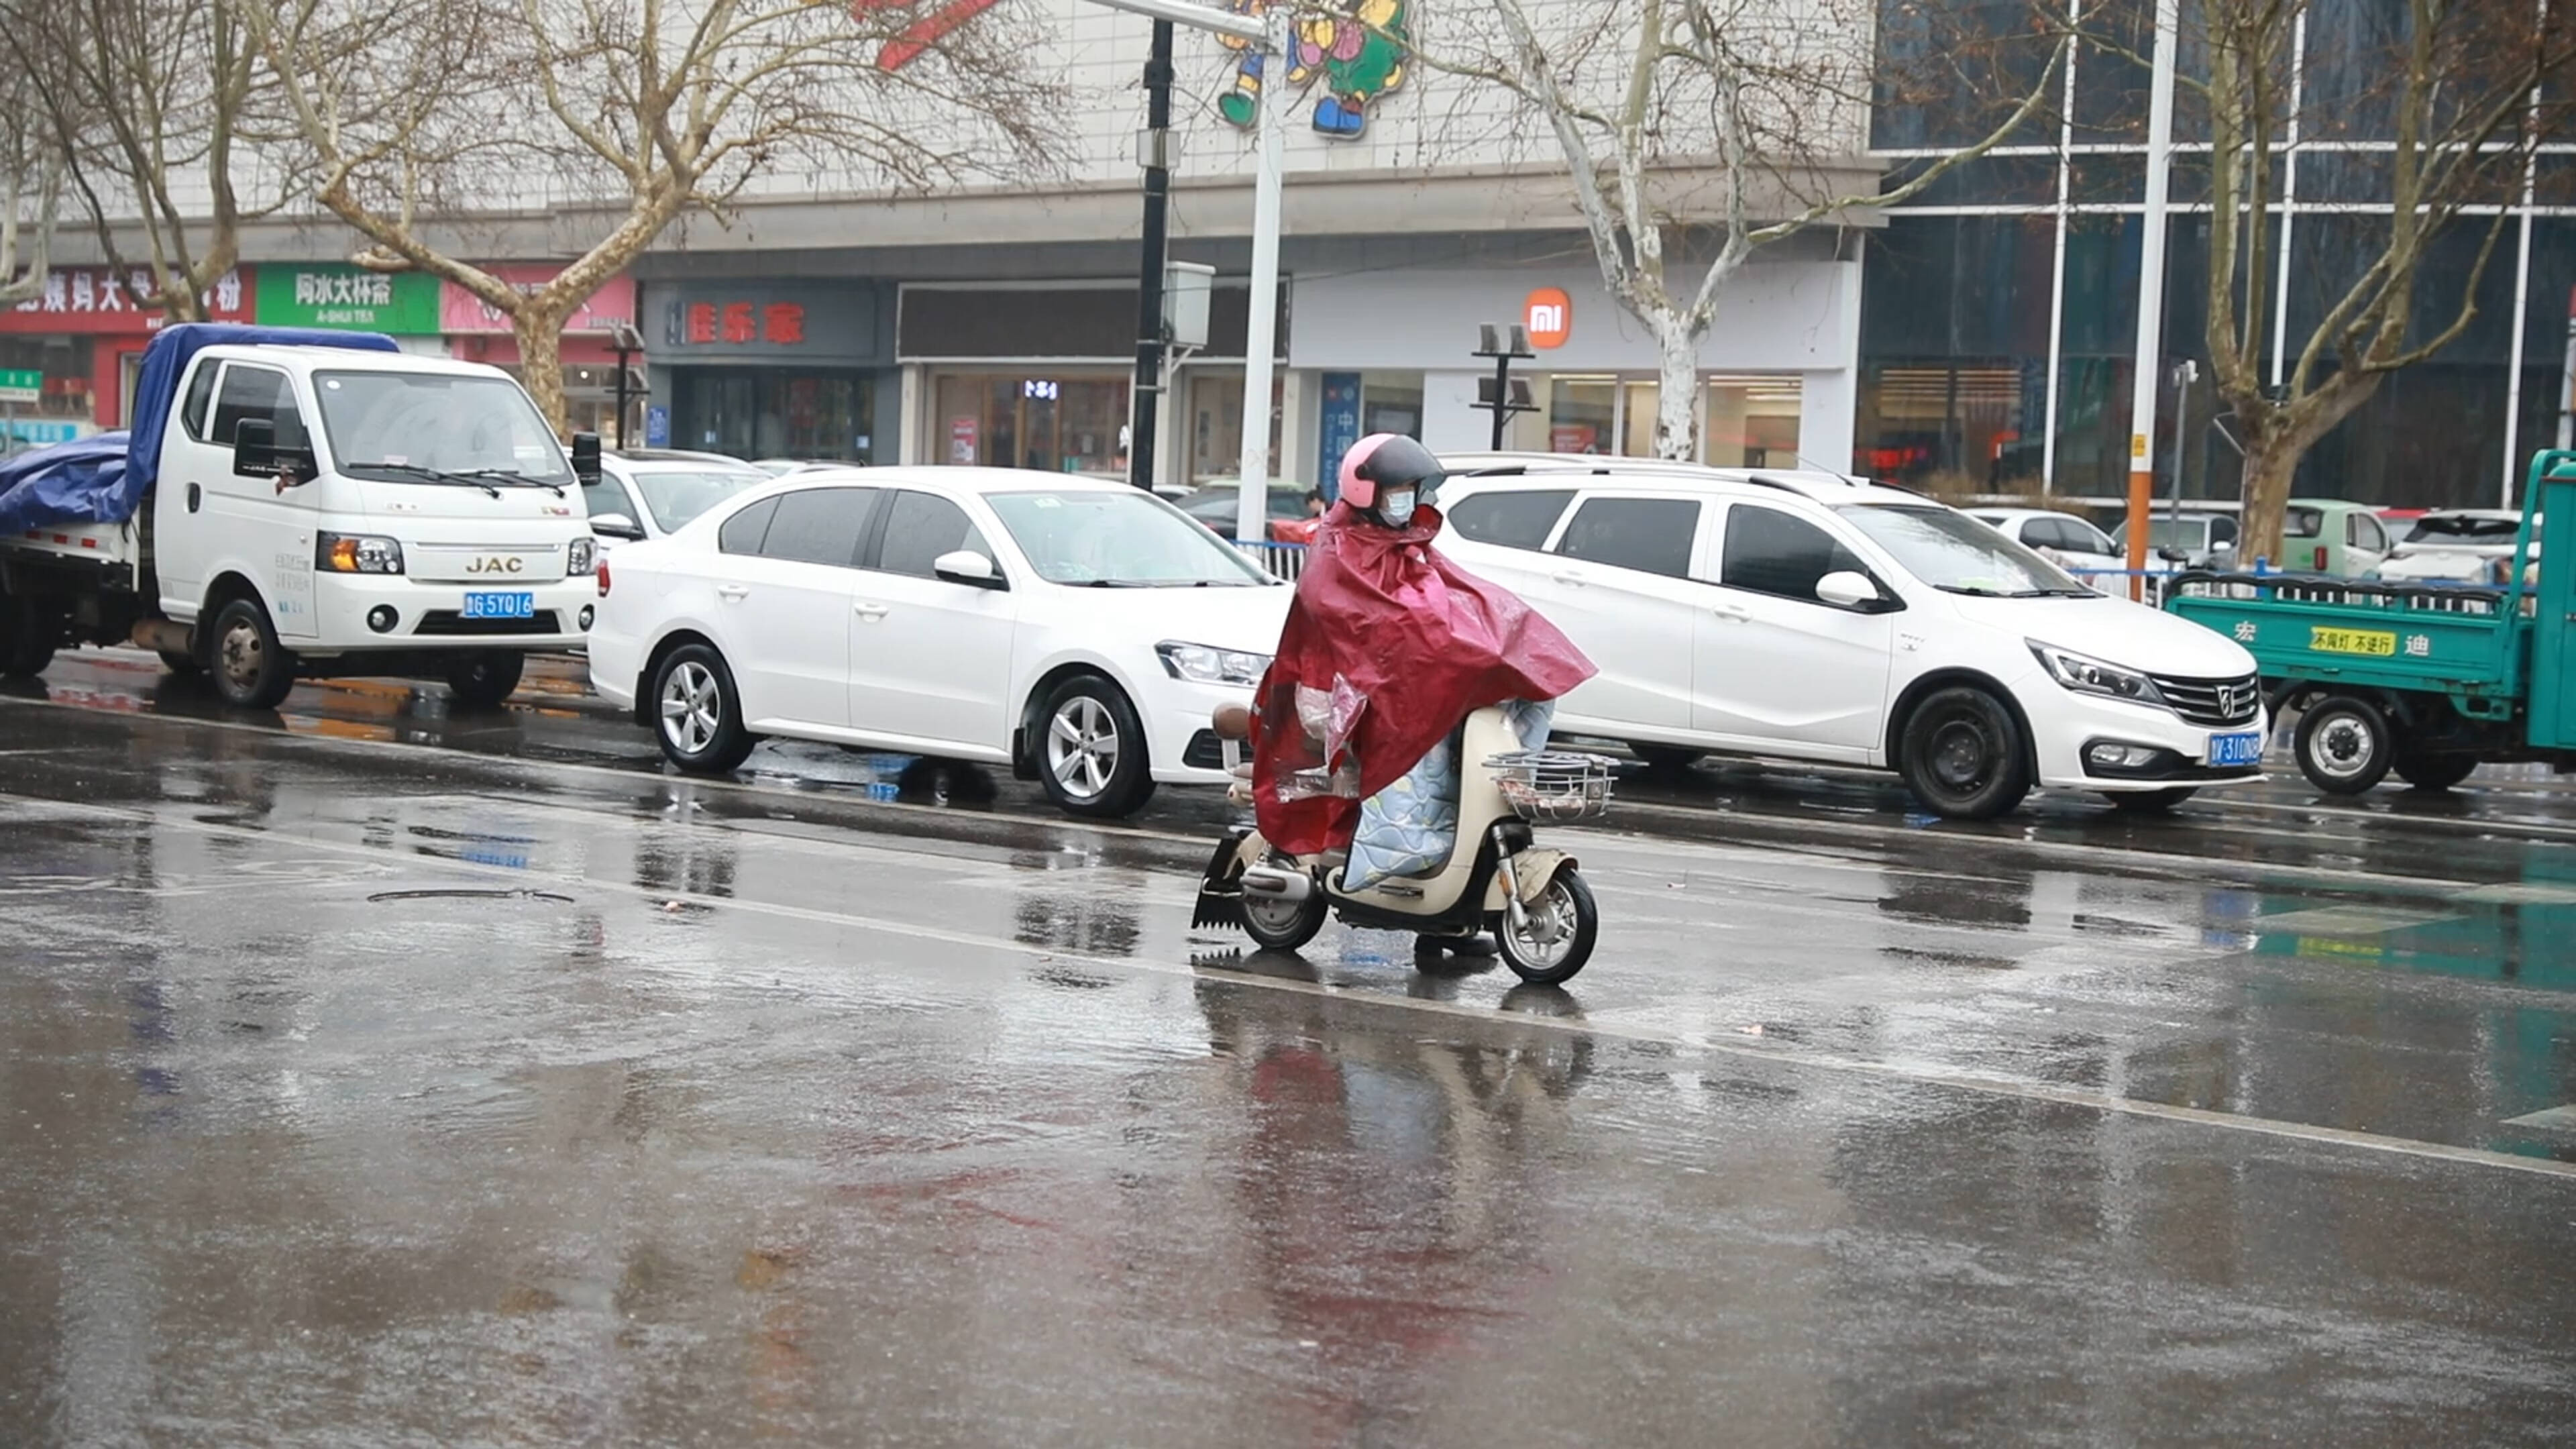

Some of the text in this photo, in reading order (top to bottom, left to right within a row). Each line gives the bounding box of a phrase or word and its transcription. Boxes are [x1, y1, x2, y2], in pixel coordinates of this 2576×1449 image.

[295, 273, 391, 305] 阿水大杯茶
[689, 302, 804, 344] 佳乐家
[466, 556, 523, 573] JAC
[2235, 621, 2430, 656] 宏 迪
[2355, 635, 2390, 653] 不逆行
